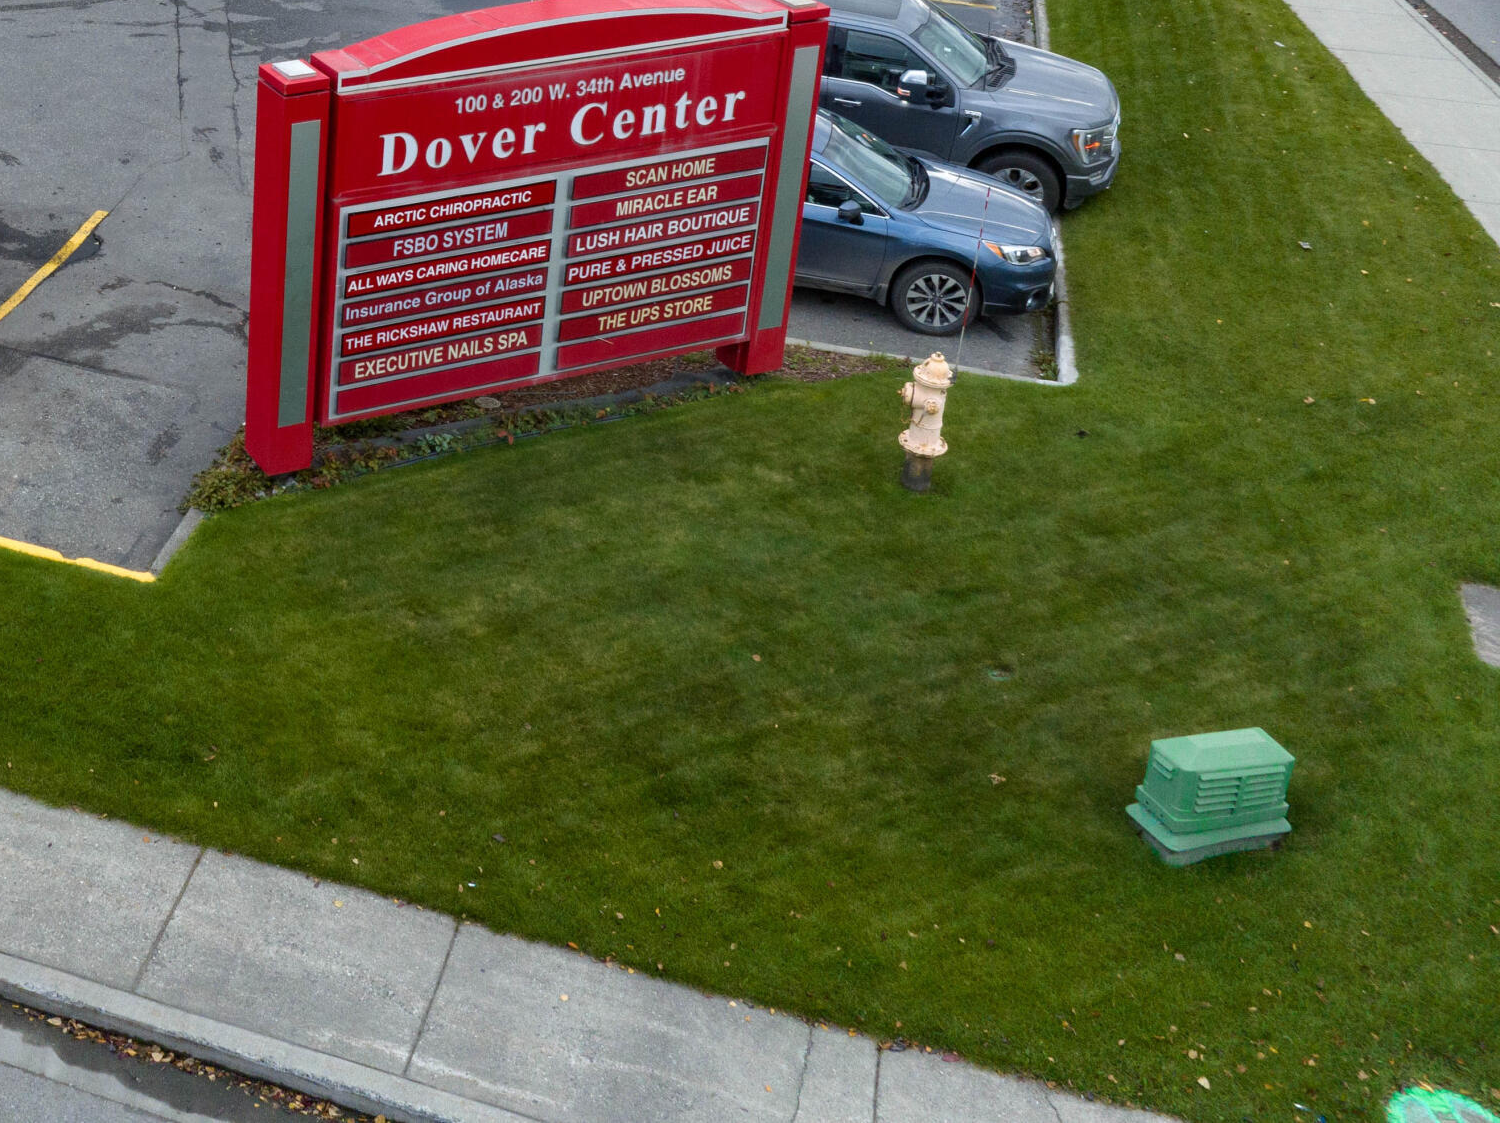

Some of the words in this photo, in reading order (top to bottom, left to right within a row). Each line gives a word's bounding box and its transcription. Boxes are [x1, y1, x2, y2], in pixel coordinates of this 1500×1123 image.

[455, 94, 487, 114] 100
[492, 93, 504, 109] &
[510, 86, 543, 106] 200
[548, 82, 570, 100] W.
[576, 77, 614, 96] 34th
[619, 67, 686, 90] Avenue
[377, 122, 546, 177] Dover
[570, 90, 746, 146] Center
[625, 166, 668, 187] SCAN
[671, 157, 716, 179] HOME
[374, 208, 426, 228] ARCTIC
[429, 190, 532, 218] CHIROPRACTIC
[616, 191, 683, 216] MIRACLE
[687, 185, 718, 204] EAR
[393, 234, 439, 257] FSBO
[443, 222, 508, 248] SYSTEM
[575, 231, 620, 252] LUSH
[624, 222, 663, 243] HAIR
[667, 207, 750, 235] BOUTIQUE
[348, 277, 374, 292] ALL
[376, 269, 414, 287] WAYS
[416, 260, 467, 279] CARING
[471, 245, 547, 270] HOMECARE
[568, 260, 612, 281] PURE
[615, 259, 627, 272] &
[631, 244, 704, 269] PRESSED
[706, 235, 751, 255] JUICE
[345, 297, 421, 321] Insurance
[425, 287, 472, 306] Group
[475, 281, 491, 296] of
[494, 272, 543, 292] Alaska
[582, 281, 648, 307] UPTOWN
[651, 265, 732, 293] BLOSSOMS
[345, 334, 373, 350] THE
[376, 319, 449, 344] RICKSHAW
[453, 302, 541, 330] RESTAURANT
[598, 312, 627, 331] THE
[630, 305, 660, 325] UPS
[663, 295, 713, 318] STORE
[354, 347, 444, 379] EXECUTIVE
[447, 337, 494, 361] NAILS
[498, 331, 528, 350] SPA
